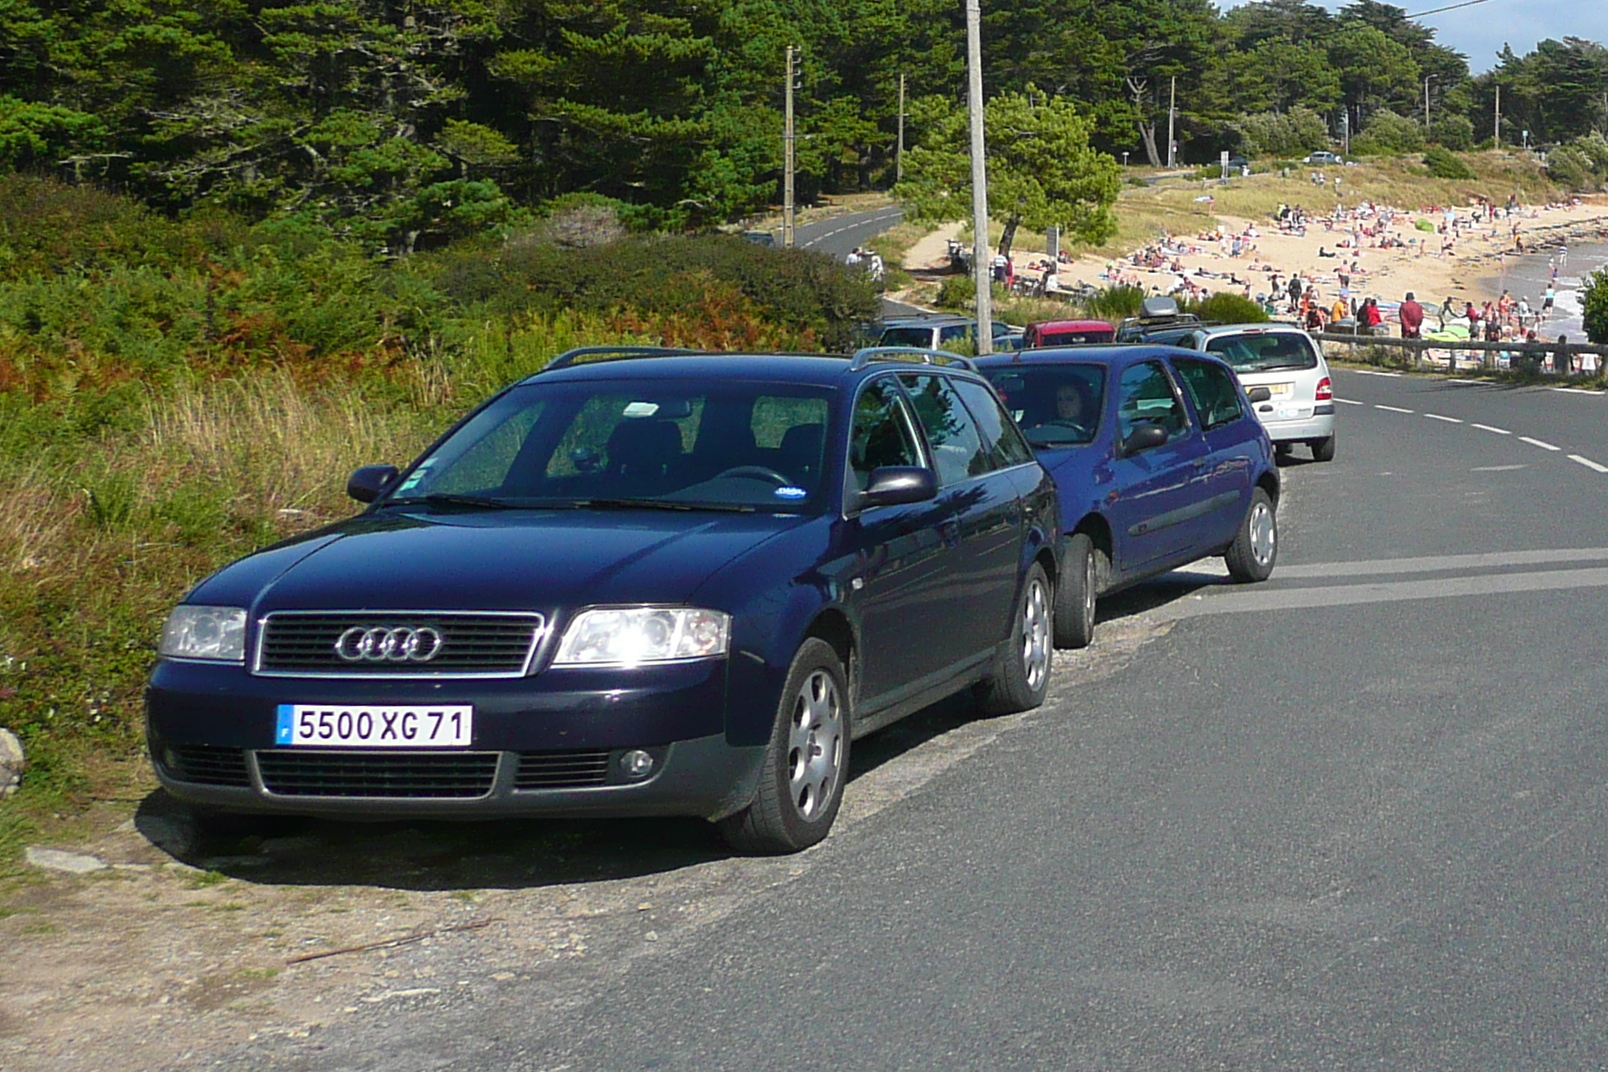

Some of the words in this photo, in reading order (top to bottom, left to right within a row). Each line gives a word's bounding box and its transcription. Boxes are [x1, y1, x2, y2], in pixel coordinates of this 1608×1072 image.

[281, 728, 289, 738] F
[299, 710, 374, 740] 5500
[380, 711, 419, 740] XG
[427, 711, 462, 740] 71
